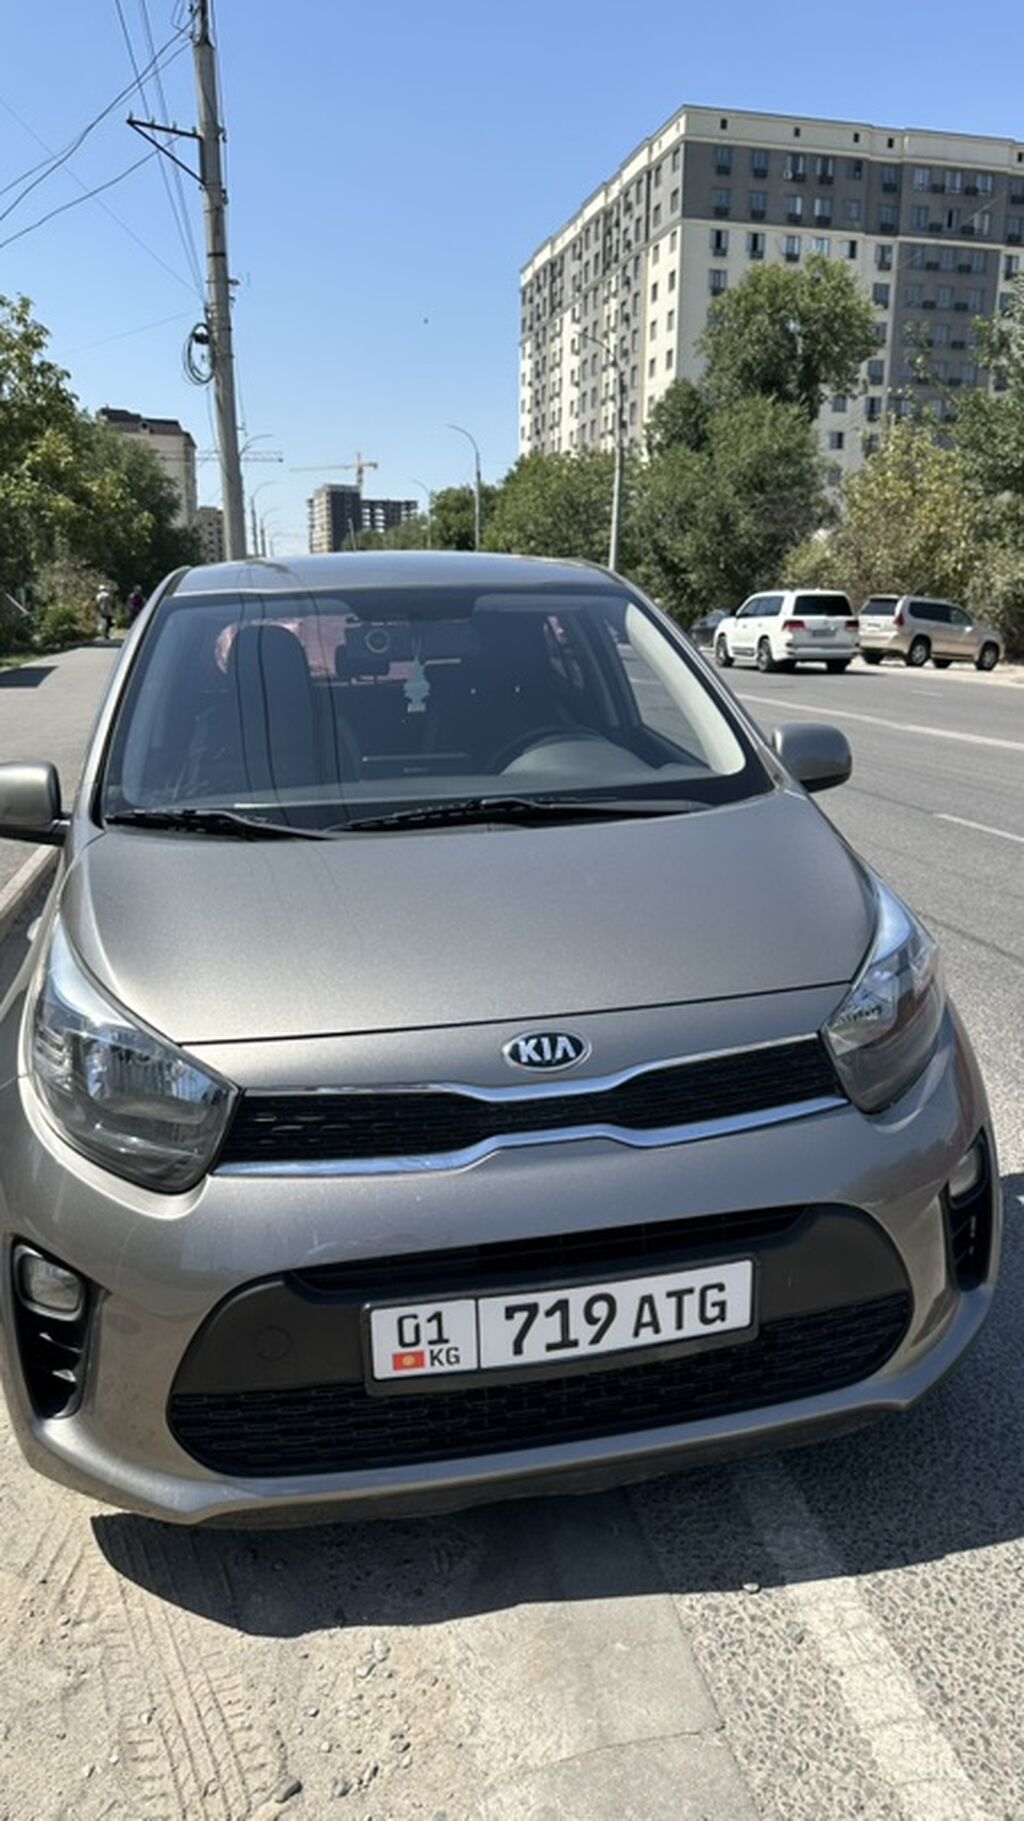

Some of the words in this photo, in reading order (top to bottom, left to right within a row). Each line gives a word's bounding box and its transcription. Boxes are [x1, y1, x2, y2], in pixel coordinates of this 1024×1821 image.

[518, 1036, 577, 1063] KIA
[397, 1311, 450, 1348] 01
[503, 1292, 618, 1357] 719
[632, 1281, 727, 1339] ATG
[428, 1347, 461, 1368] KG
